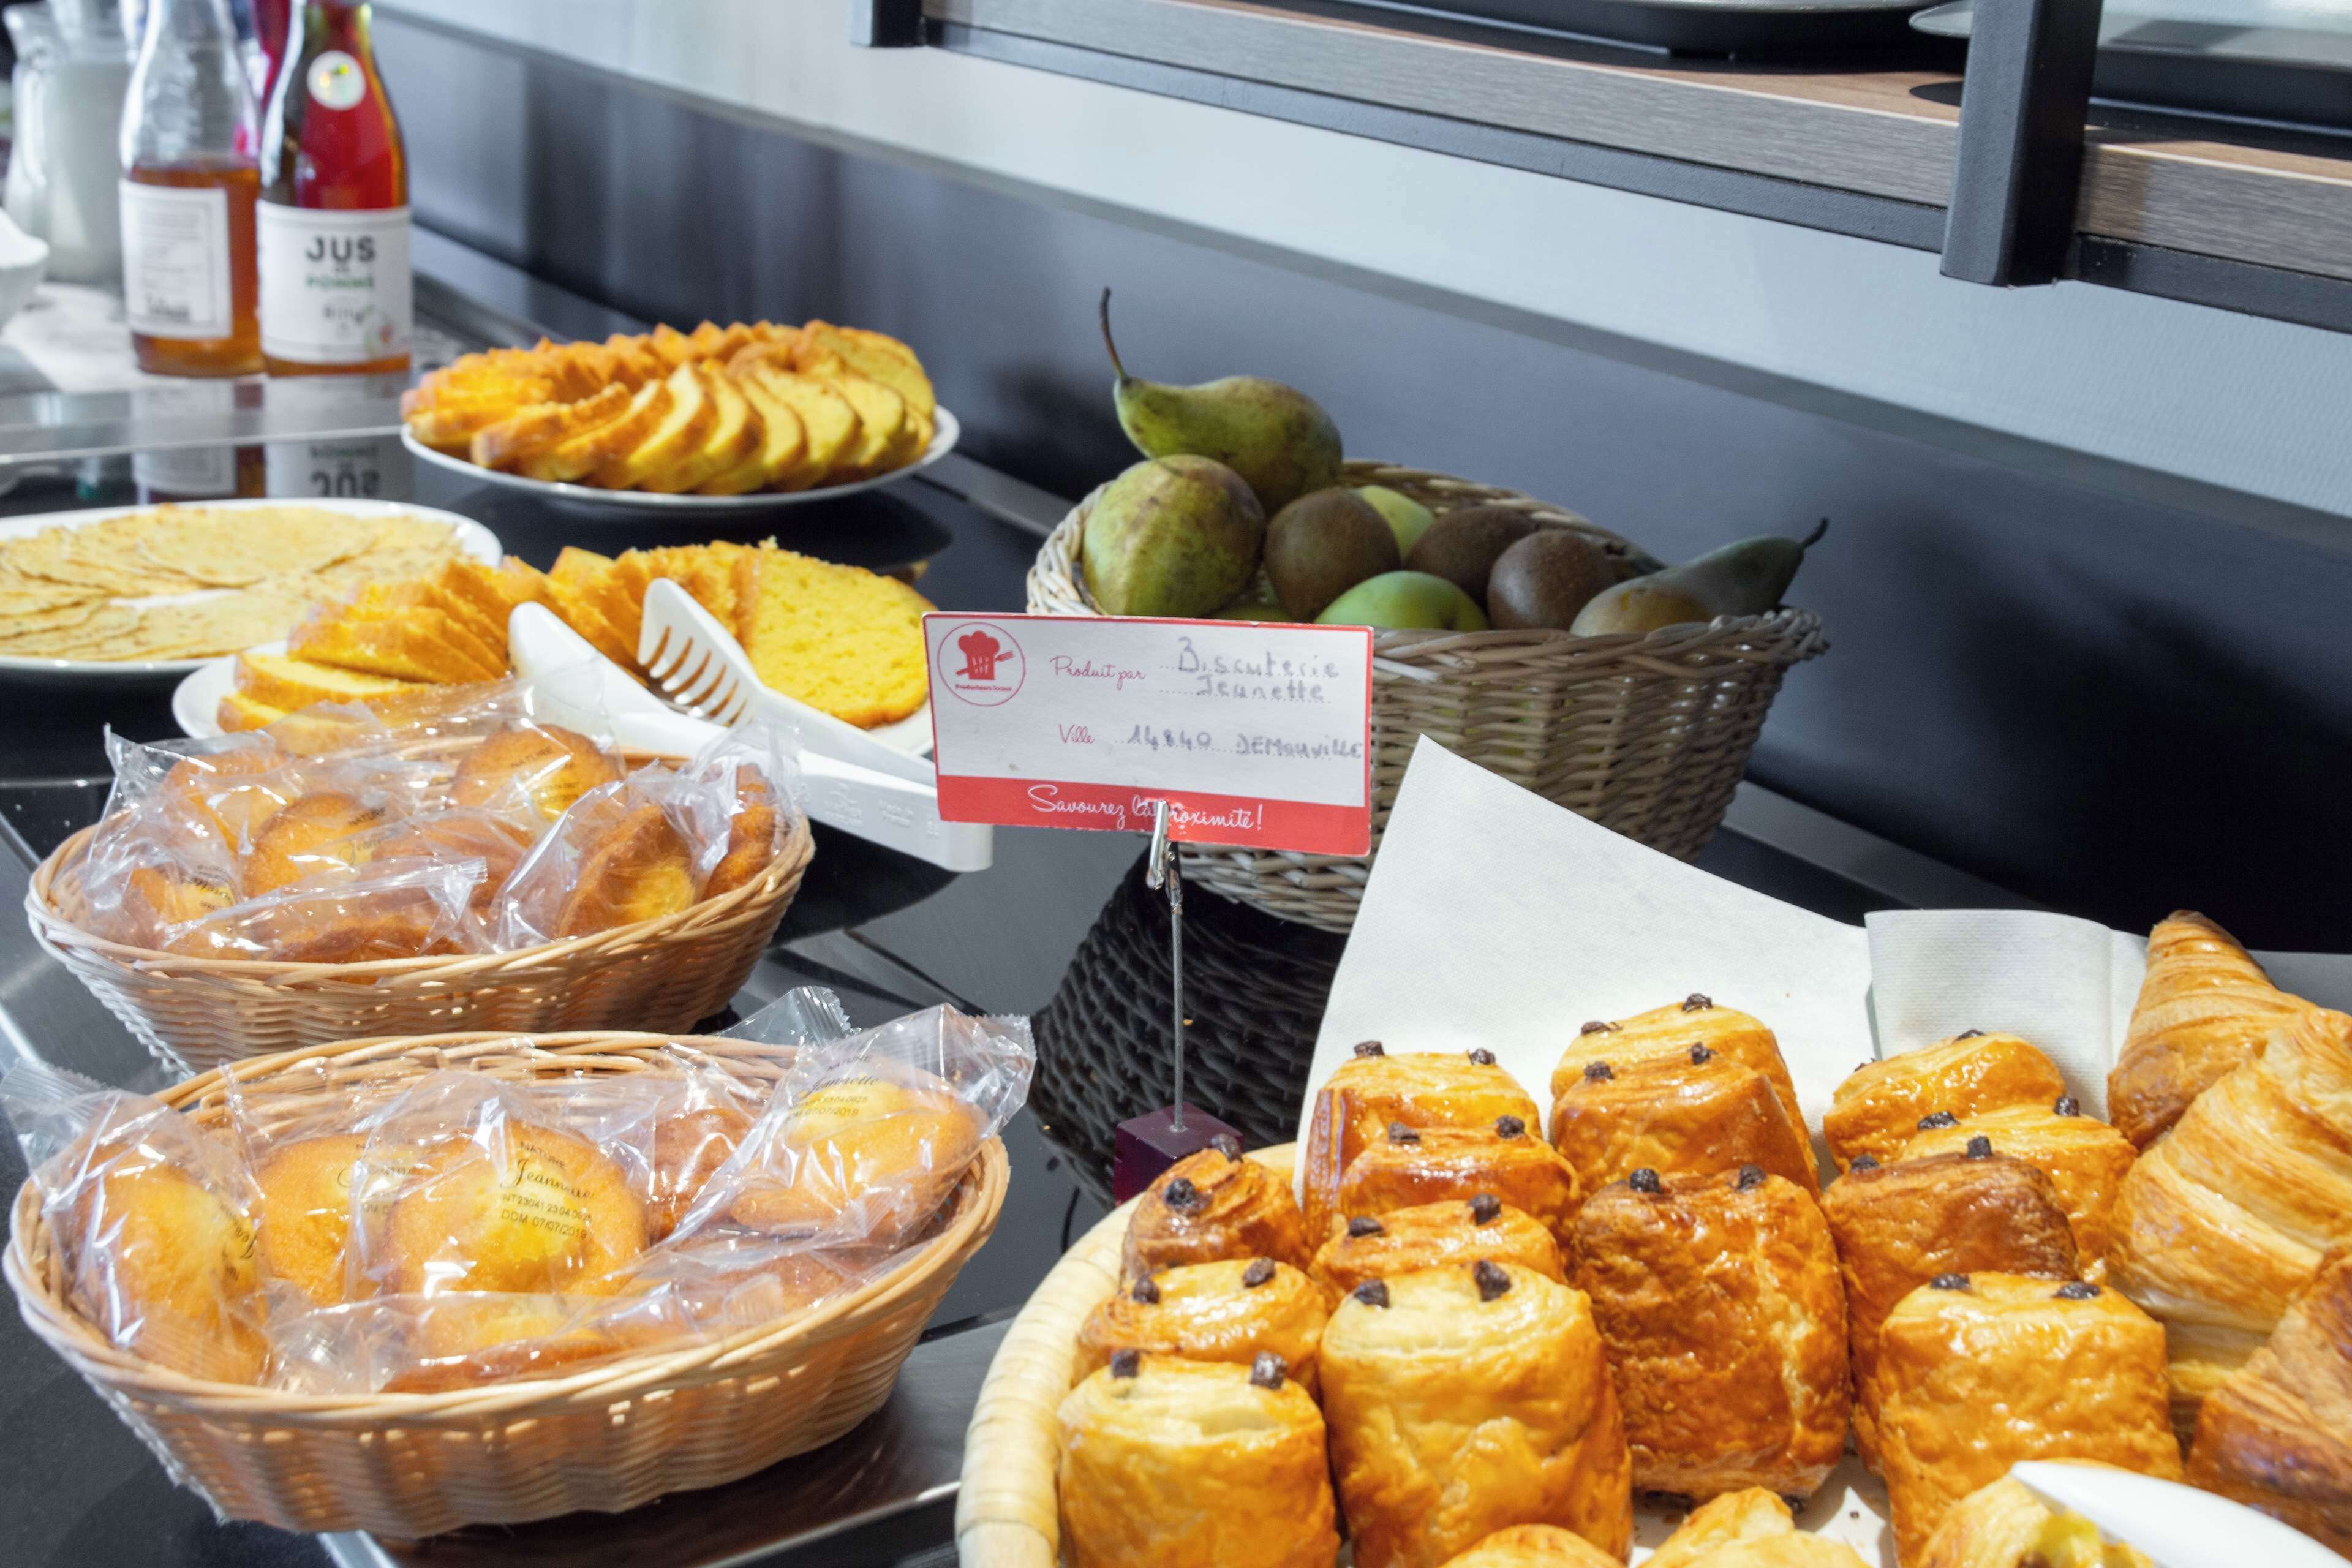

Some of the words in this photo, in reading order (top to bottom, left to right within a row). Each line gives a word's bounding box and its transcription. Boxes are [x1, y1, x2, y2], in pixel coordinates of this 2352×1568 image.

[306, 235, 375, 263] JUS
[1049, 655, 1115, 678] Produit
[1116, 670, 1146, 691] par
[1058, 724, 1095, 744] Ville
[1027, 783, 1126, 829] Savourez
[520, 1140, 567, 1170] NATURE
[501, 1208, 529, 1225] DDM
